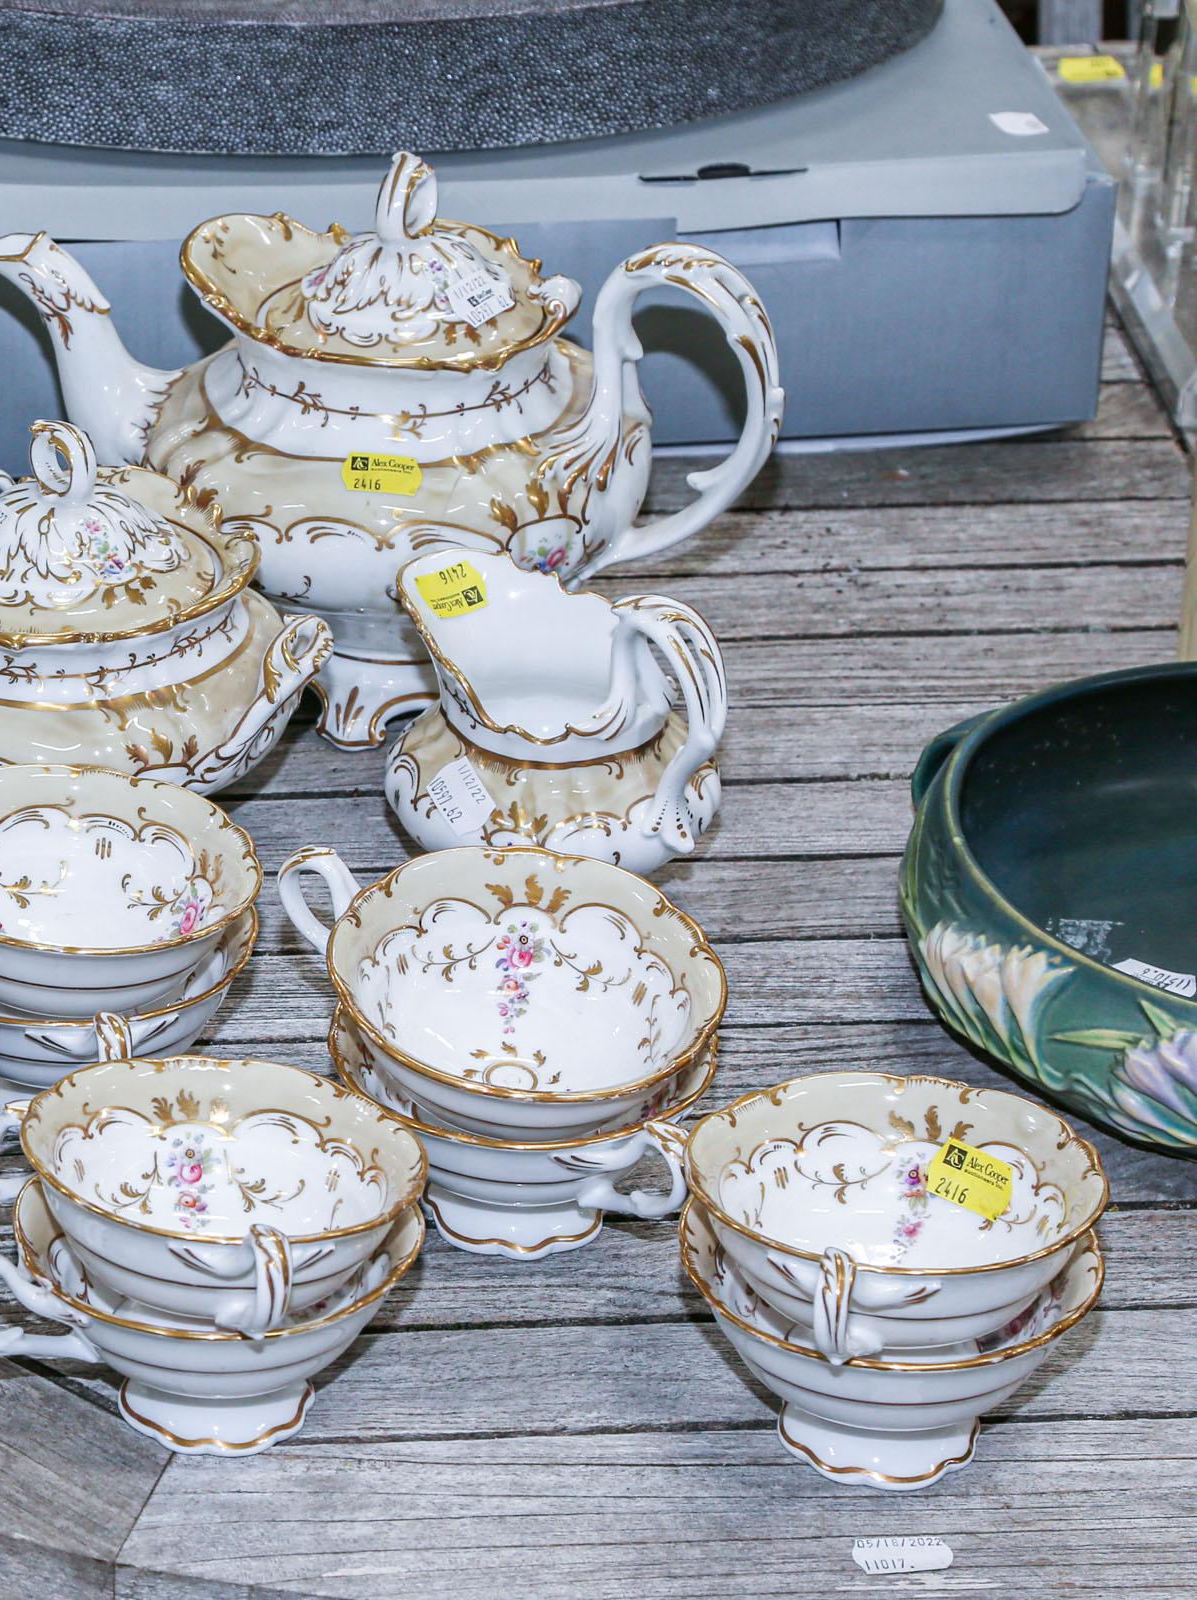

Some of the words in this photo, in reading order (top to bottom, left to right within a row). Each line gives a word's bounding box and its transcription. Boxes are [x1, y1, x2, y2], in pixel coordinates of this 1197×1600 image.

[354, 478, 381, 490] 2416
[439, 563, 467, 585] 2416
[458, 764, 487, 805] 1/12/22
[429, 776, 463, 824] 10597.62
[967, 1156, 985, 1173] Alex
[984, 1163, 1009, 1185] Cooper
[934, 1177, 969, 1204] 2416
[857, 1537, 944, 1549] 05/18/2022
